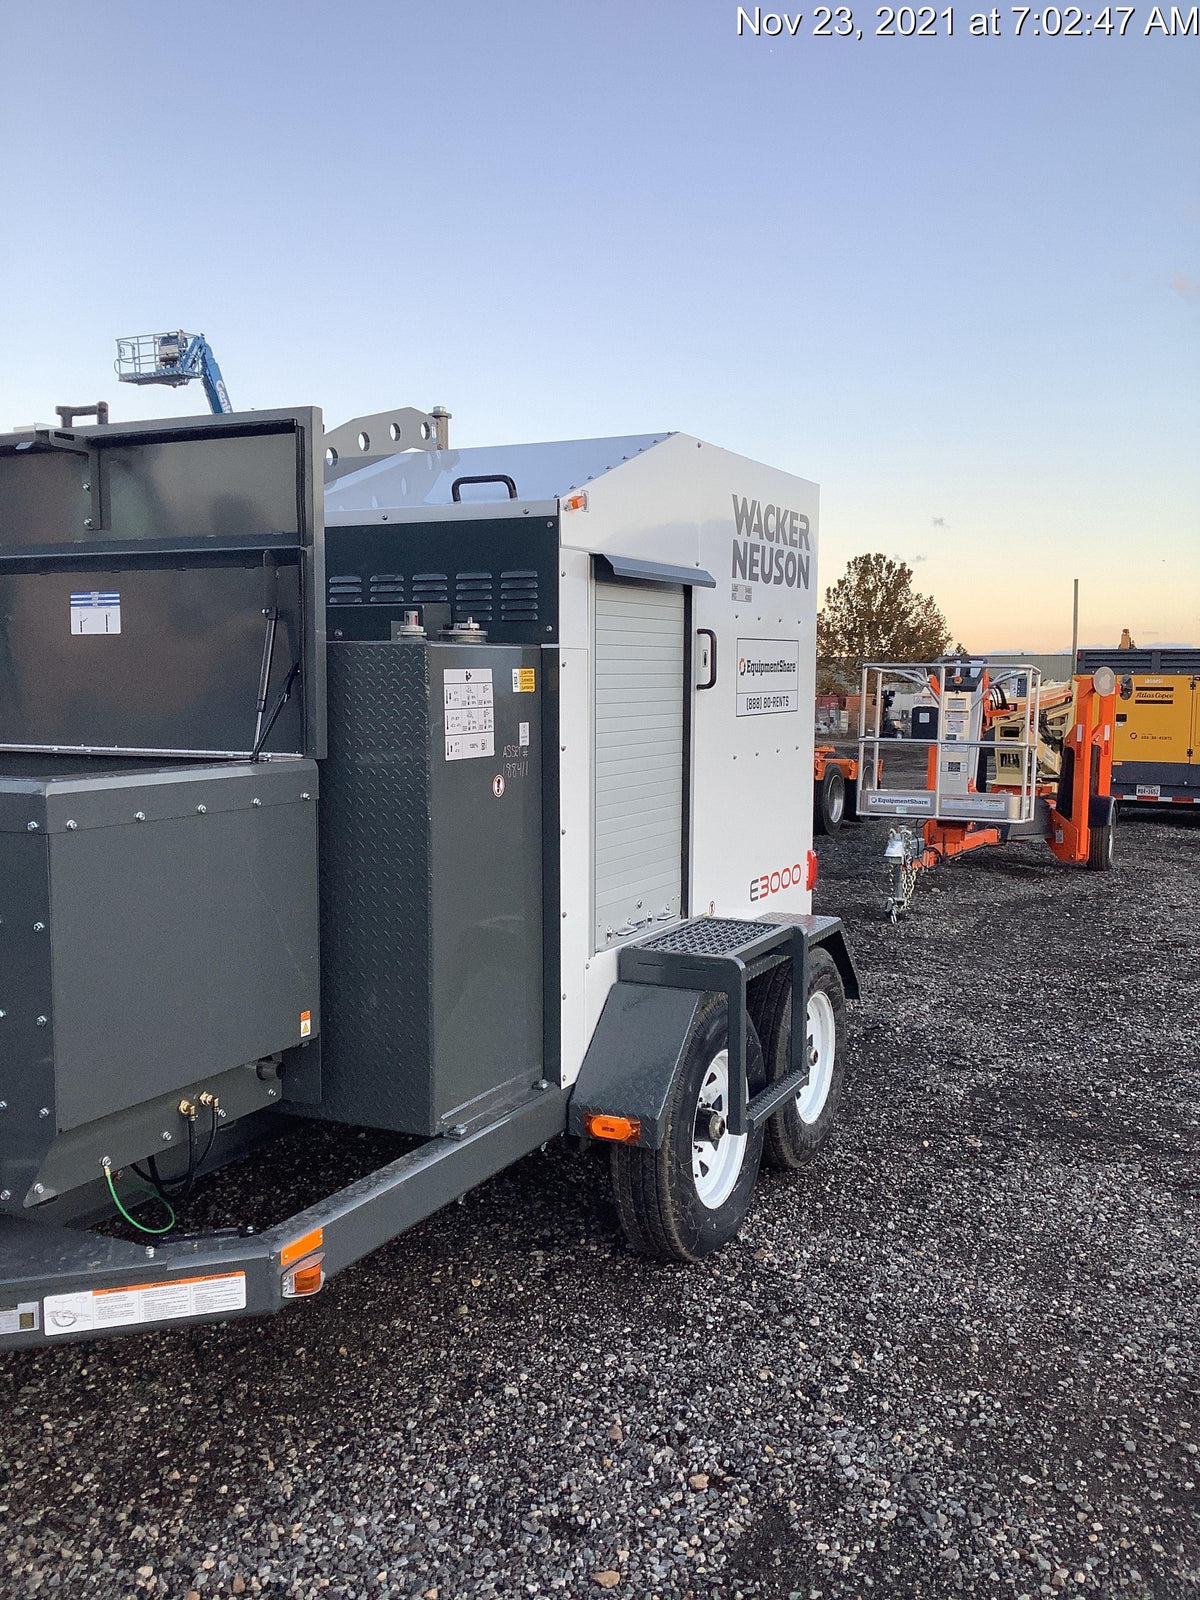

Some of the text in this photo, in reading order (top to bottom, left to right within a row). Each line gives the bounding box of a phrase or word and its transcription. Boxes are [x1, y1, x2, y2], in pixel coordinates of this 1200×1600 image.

[731, 493, 810, 551] WACKER
[731, 538, 810, 590] NEUSON
[746, 659, 796, 676] EquipmentShare
[746, 695, 790, 711] (888) 80-RENTS
[877, 797, 929, 805] EquipmentShare
[749, 863, 801, 902] E3000
